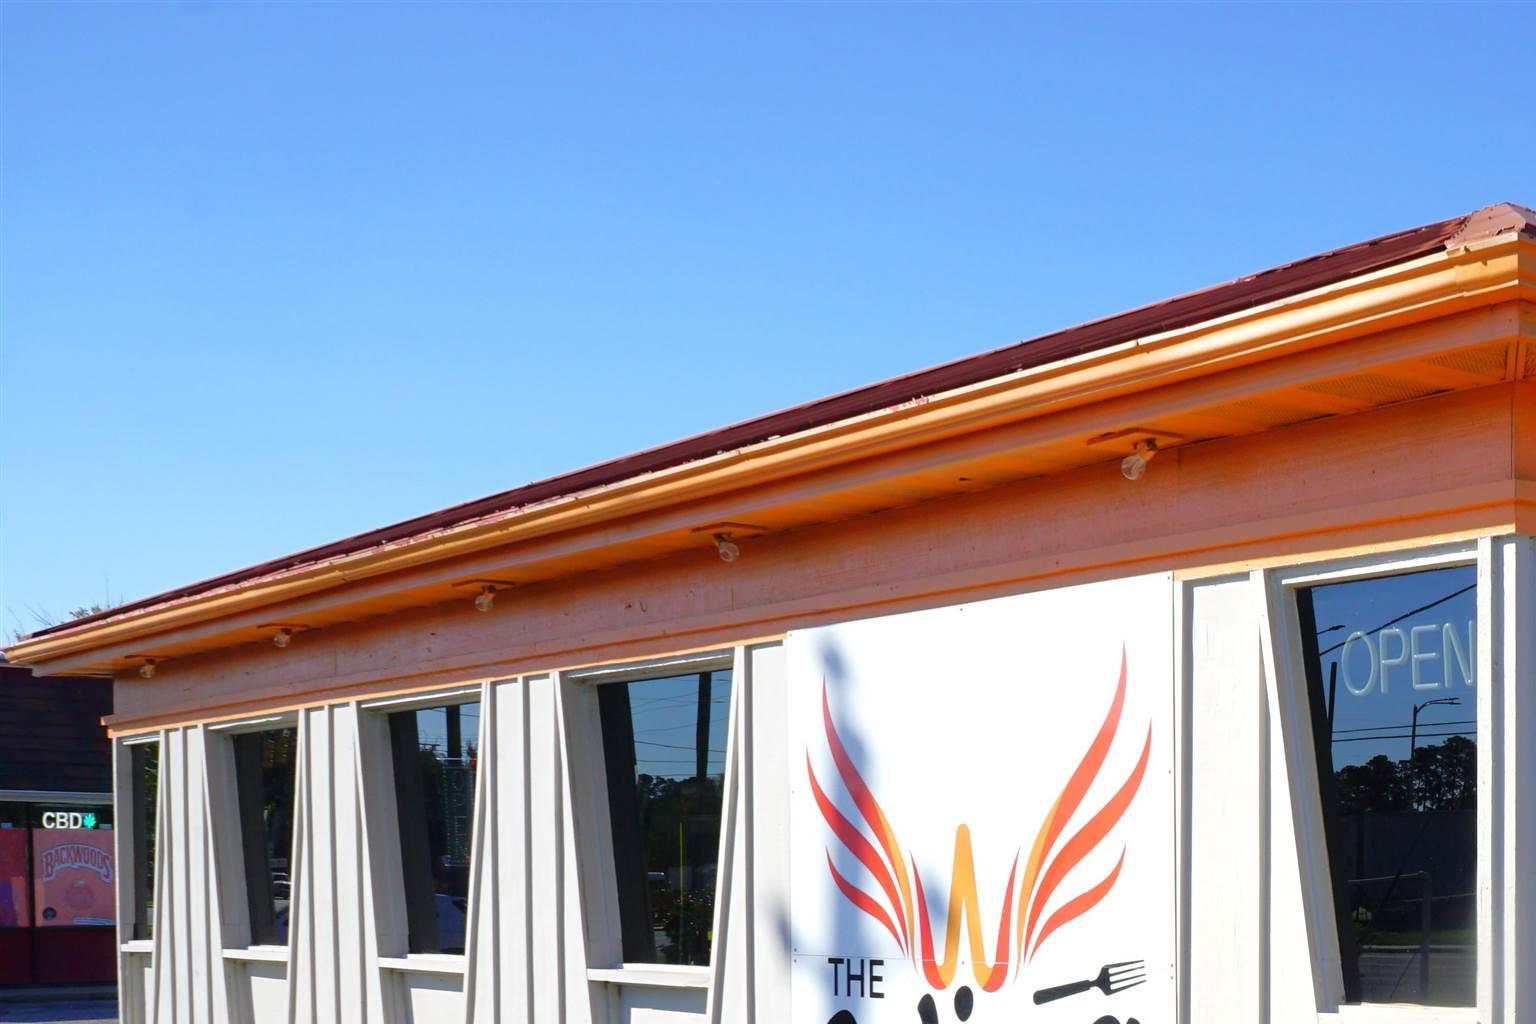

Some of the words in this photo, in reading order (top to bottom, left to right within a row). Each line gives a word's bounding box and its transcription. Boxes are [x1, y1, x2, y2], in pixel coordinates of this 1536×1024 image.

[1341, 620, 1477, 696] OPEN
[42, 811, 82, 829] CBD
[42, 844, 112, 882] BACKWOODS
[827, 957, 885, 999] THE
